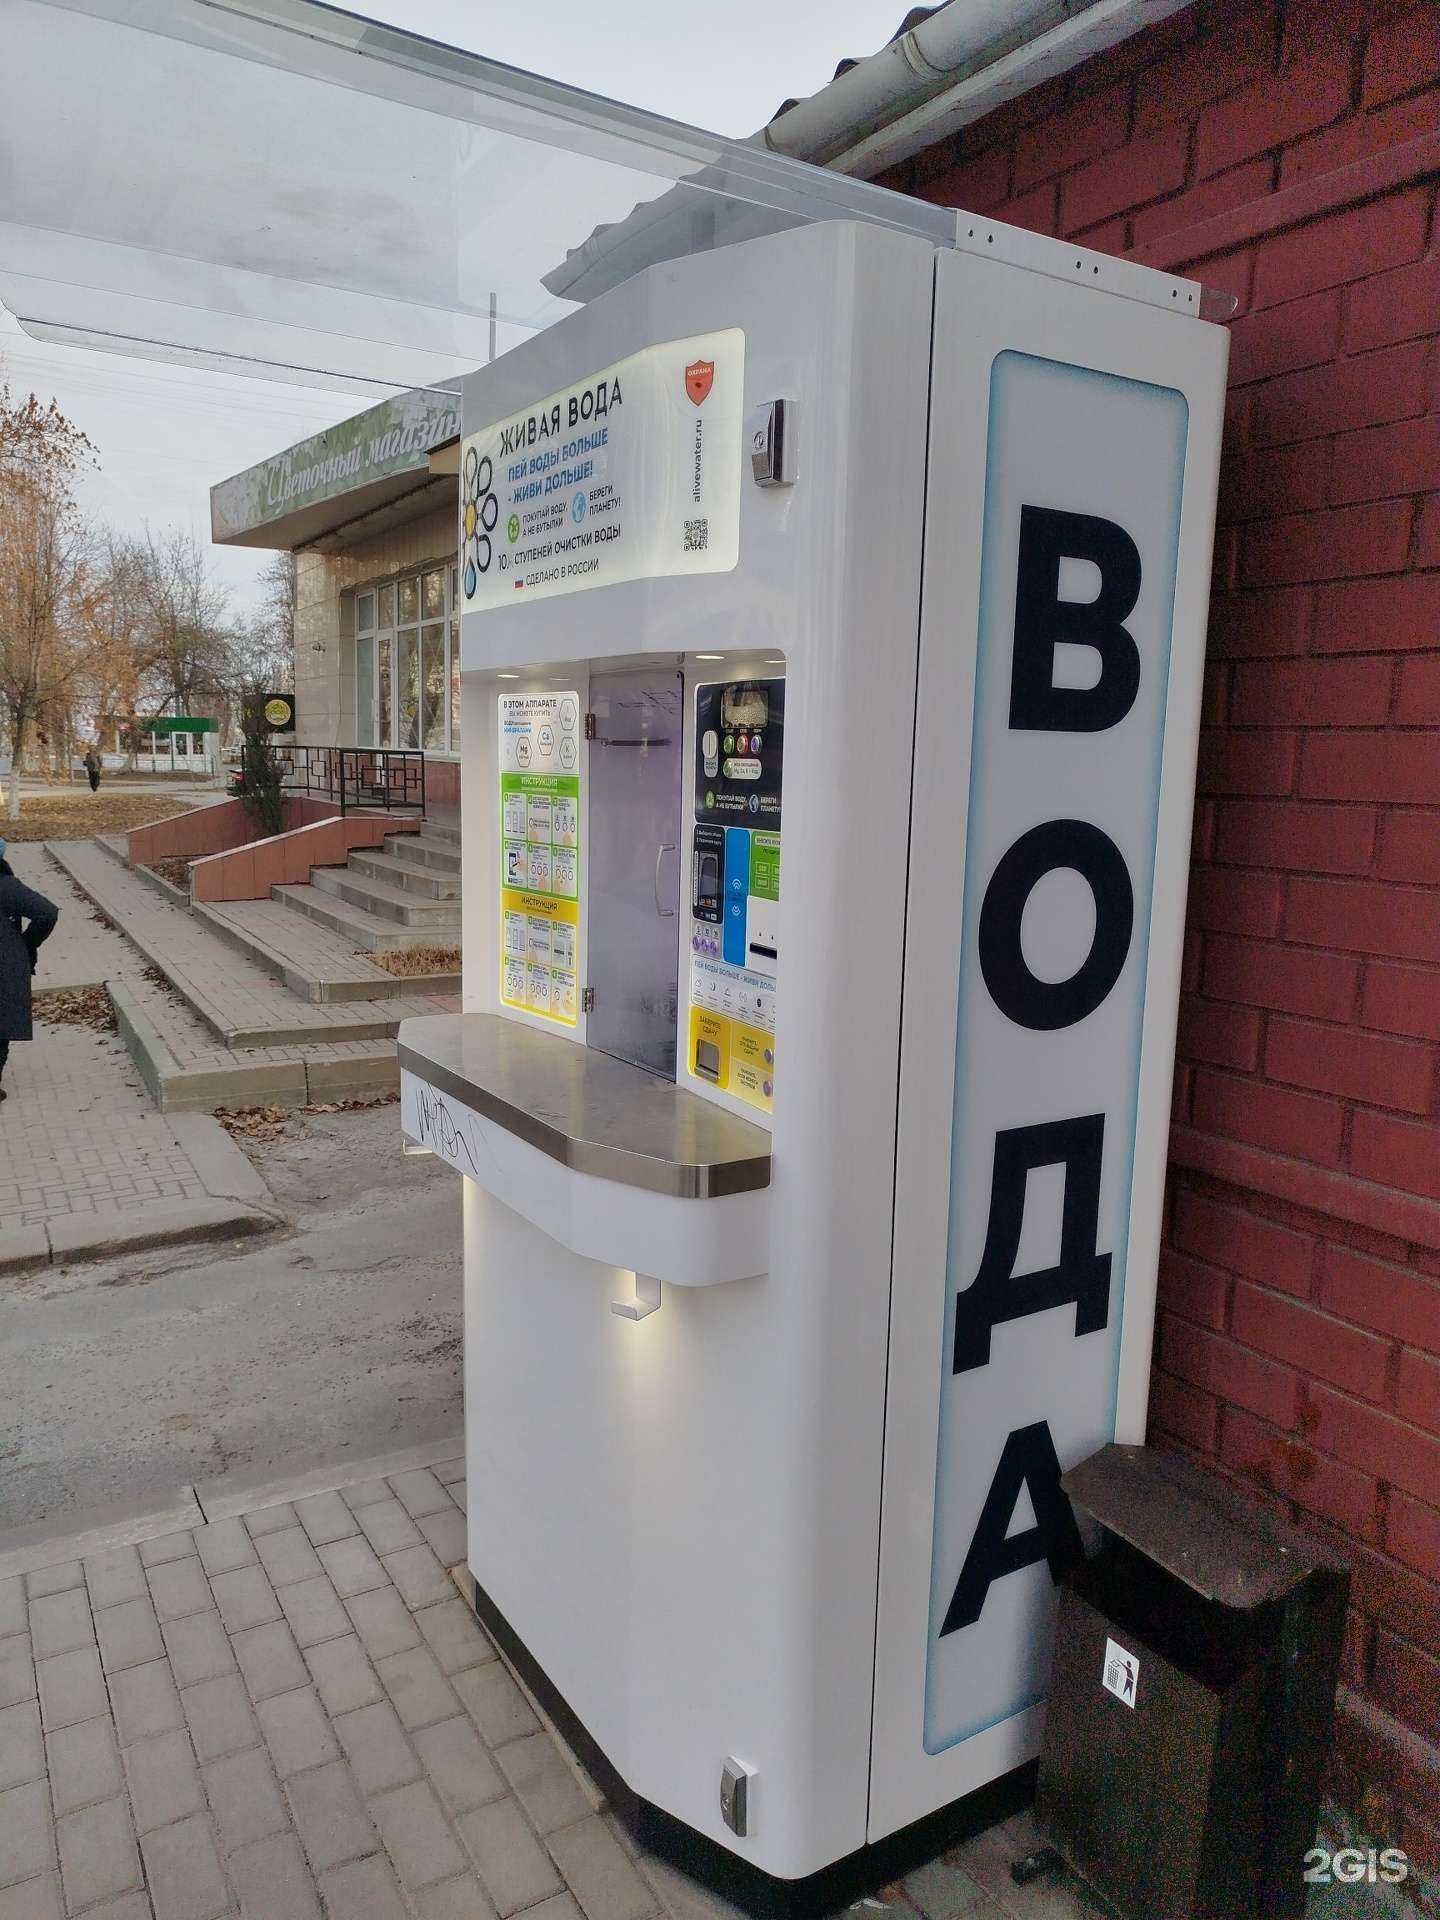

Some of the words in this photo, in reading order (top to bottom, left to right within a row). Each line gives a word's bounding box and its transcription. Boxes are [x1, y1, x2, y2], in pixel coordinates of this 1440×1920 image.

[500, 405, 560, 458] ЖИВАЯ
[568, 377, 623, 427] ВОДА
[507, 463, 527, 482] ПЕЙ
[529, 447, 559, 475] ВОДЫ
[562, 427, 608, 461] БОЛЬШЕ
[692, 419, 702, 503] alivewater.ru
[513, 482, 542, 504] ЖИВИ
[545, 460, 593, 495] ДОЛЬШЕ!
[589, 484, 613, 501] БЕРЕГИ
[522, 507, 550, 523] ПОКУПАЙ
[589, 497, 621, 516] ПЛАНЕТУ!
[527, 524, 536, 536] НЕ
[536, 517, 563, 535] БУТЫЛКИ
[514, 542, 552, 565] СТУПЕНЕЙ
[554, 533, 592, 554] ОЧИСТКИ
[594, 524, 621, 544] ВОДЫ
[526, 568, 560, 587] СДЕЛАНО
[561, 567, 567, 578] В
[567, 557, 599, 576] РОССИИ
[508, 700, 524, 709] ЭТОМ
[525, 699, 557, 708] АППАРАТЕ
[521, 776, 558, 787] ИНСТРУКЦИЯ
[521, 897, 558, 911] ИНСТРУКЦИЯ
[939, 503, 1142, 1639] ВОДА
